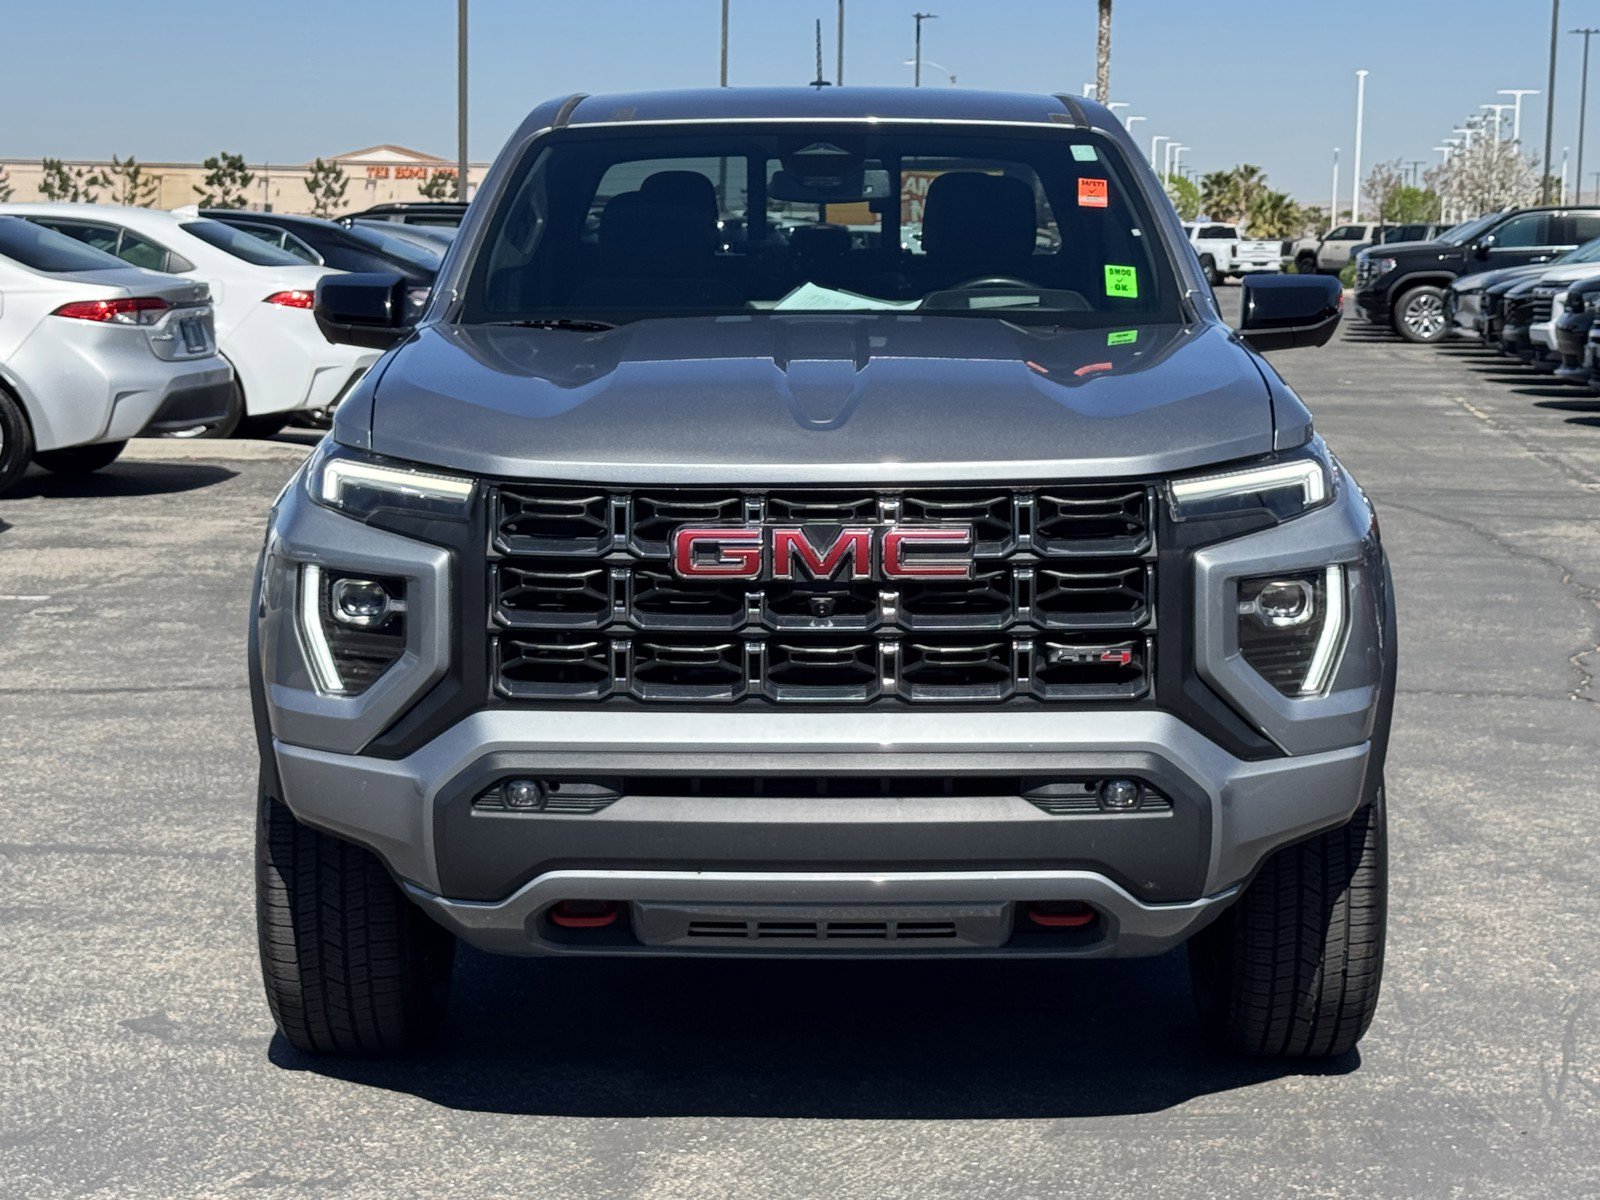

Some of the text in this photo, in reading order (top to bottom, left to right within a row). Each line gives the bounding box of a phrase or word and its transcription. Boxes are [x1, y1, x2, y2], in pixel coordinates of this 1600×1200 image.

[1108, 268, 1132, 277] SMOG
[1114, 283, 1129, 292] OK
[671, 525, 975, 581] GMC
[1049, 647, 1132, 666] AT4
